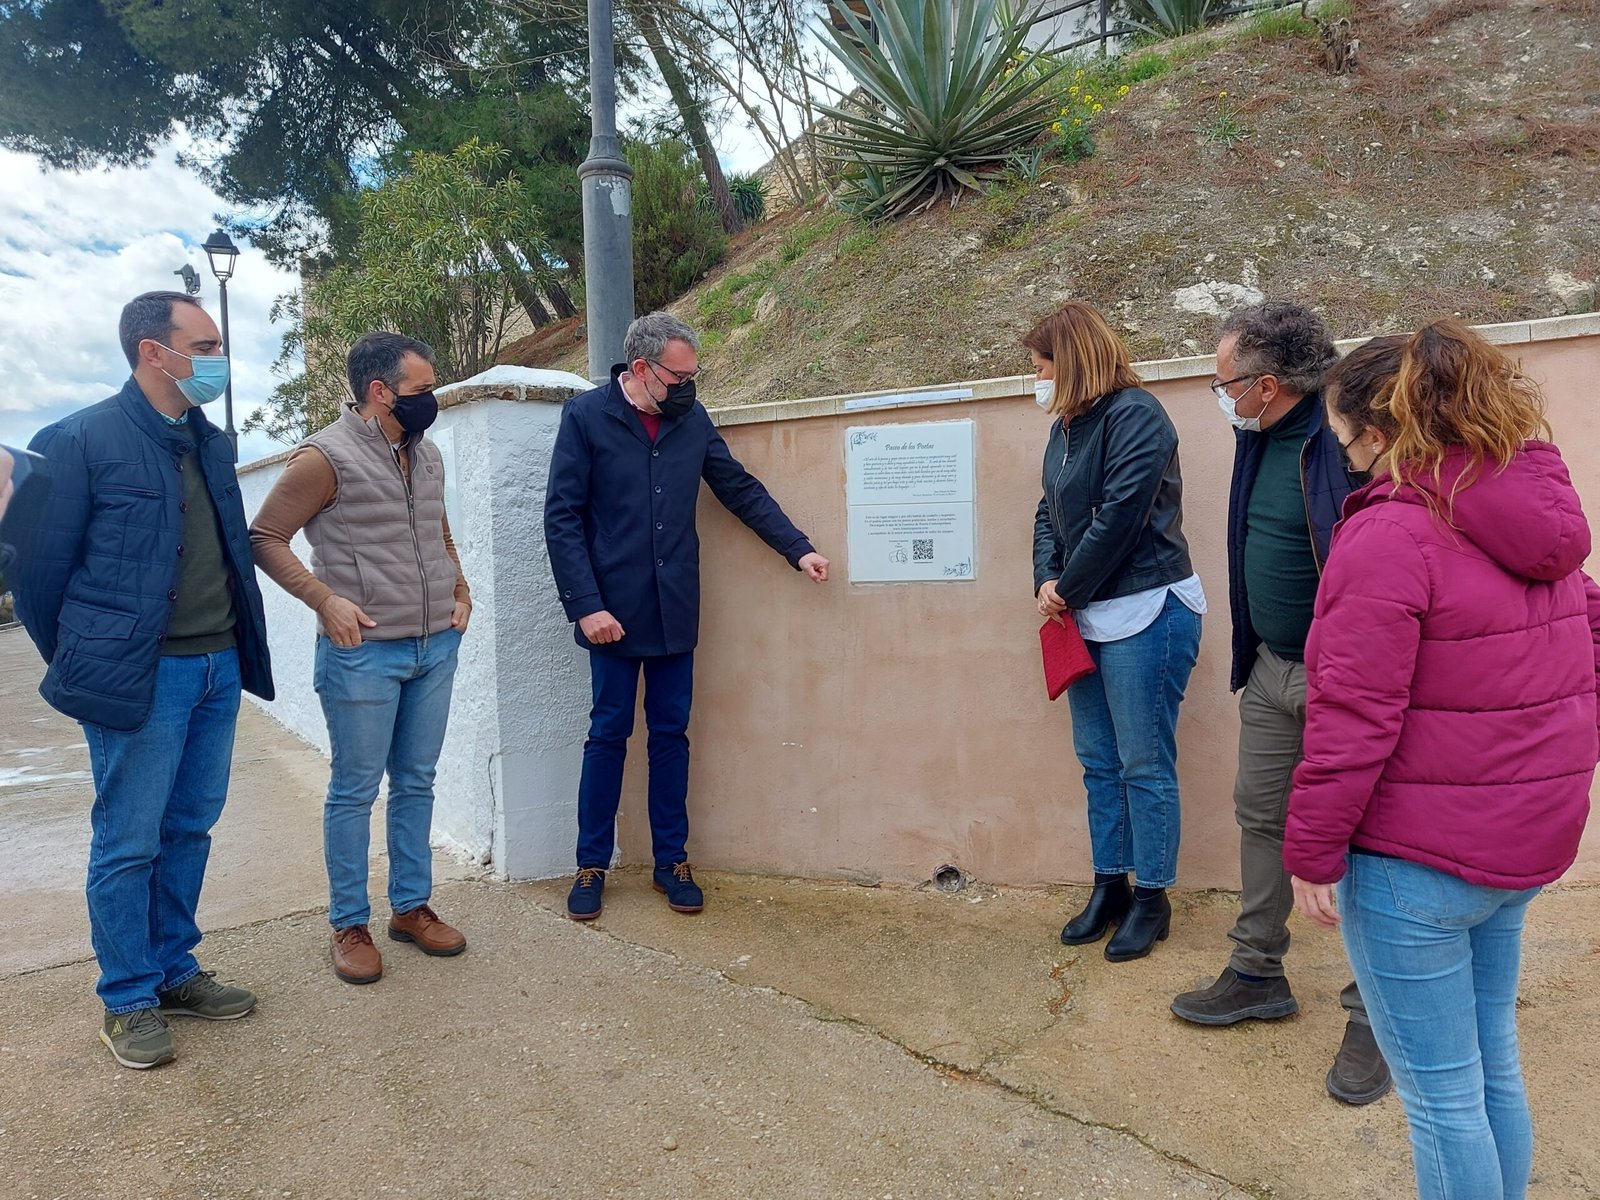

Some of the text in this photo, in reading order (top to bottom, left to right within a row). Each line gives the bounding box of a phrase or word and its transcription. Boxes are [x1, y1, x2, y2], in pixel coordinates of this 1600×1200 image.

[901, 442, 908, 450] de
[908, 442, 916, 450] los
[917, 442, 934, 450] Poetas
